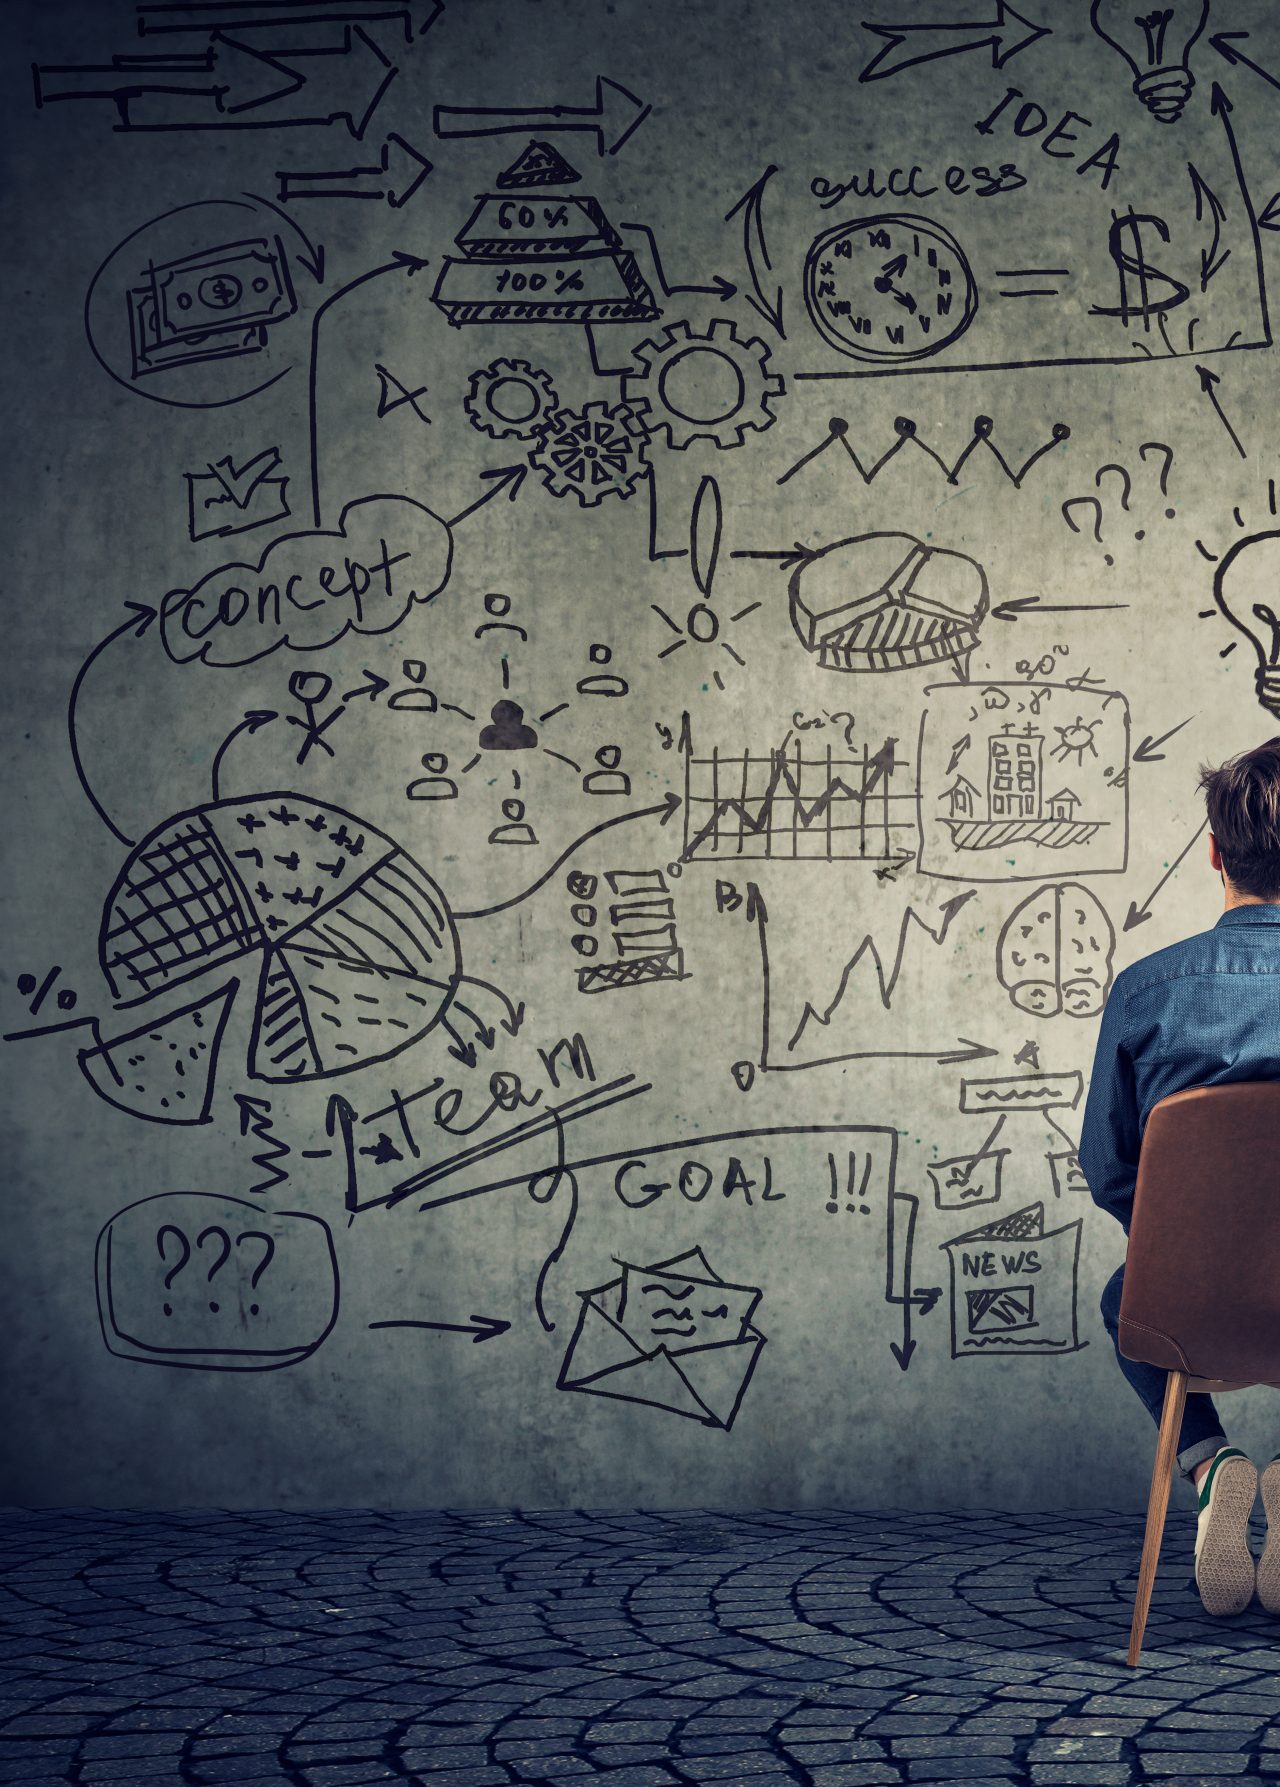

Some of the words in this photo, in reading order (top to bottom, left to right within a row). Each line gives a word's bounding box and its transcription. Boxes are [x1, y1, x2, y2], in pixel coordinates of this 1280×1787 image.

[975, 87, 1120, 189] IDEA
[181, 538, 411, 639] concept
[17, 966, 77, 1015] %
[615, 1159, 786, 1208] GOAL
[826, 1152, 872, 1215] !!!
[157, 1224, 275, 1316] ???
[962, 1251, 1042, 1277] NEWS
